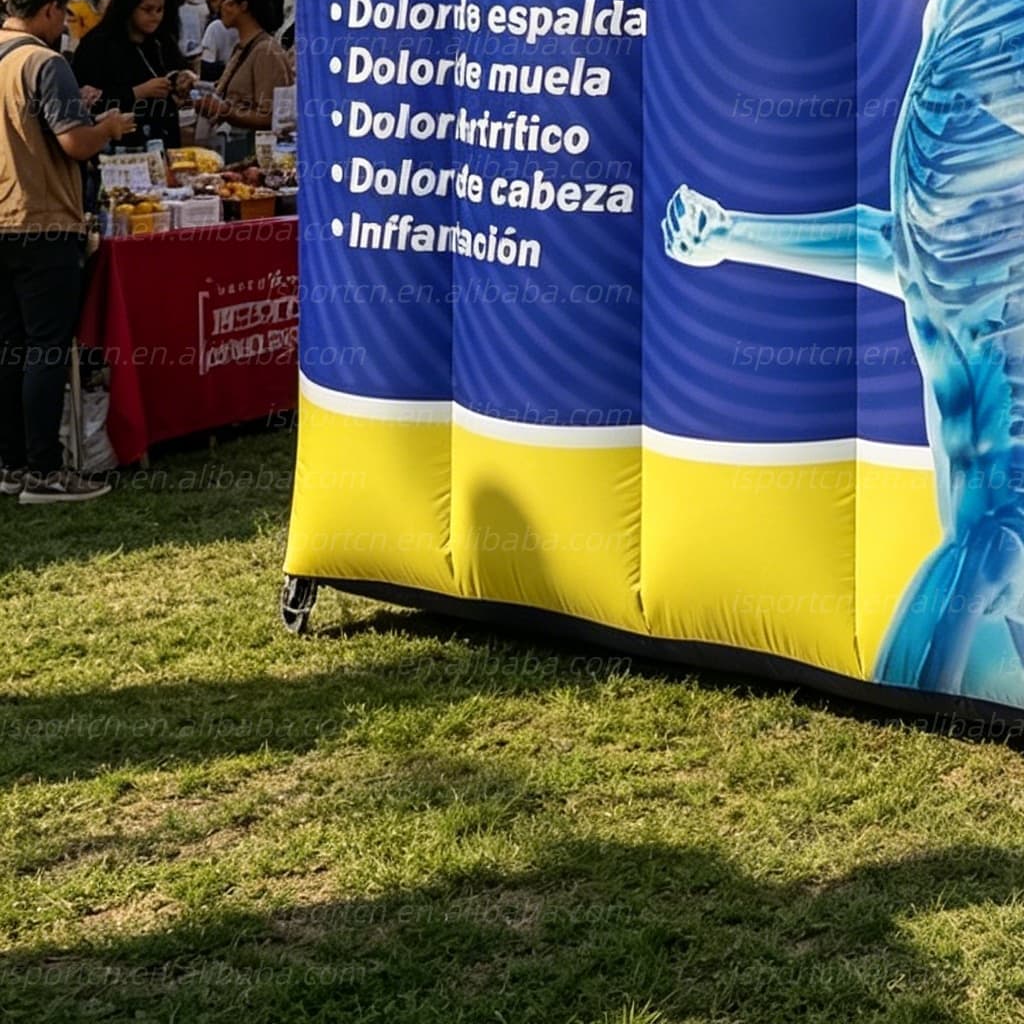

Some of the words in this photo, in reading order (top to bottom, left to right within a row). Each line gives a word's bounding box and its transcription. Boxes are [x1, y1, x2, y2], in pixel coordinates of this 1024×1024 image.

[347, 46, 455, 85] Dolor
[488, 57, 611, 96] muela
[348, 101, 455, 140] Dolor
[350, 157, 455, 196] Dolor
[490, 170, 635, 213] cabeza
